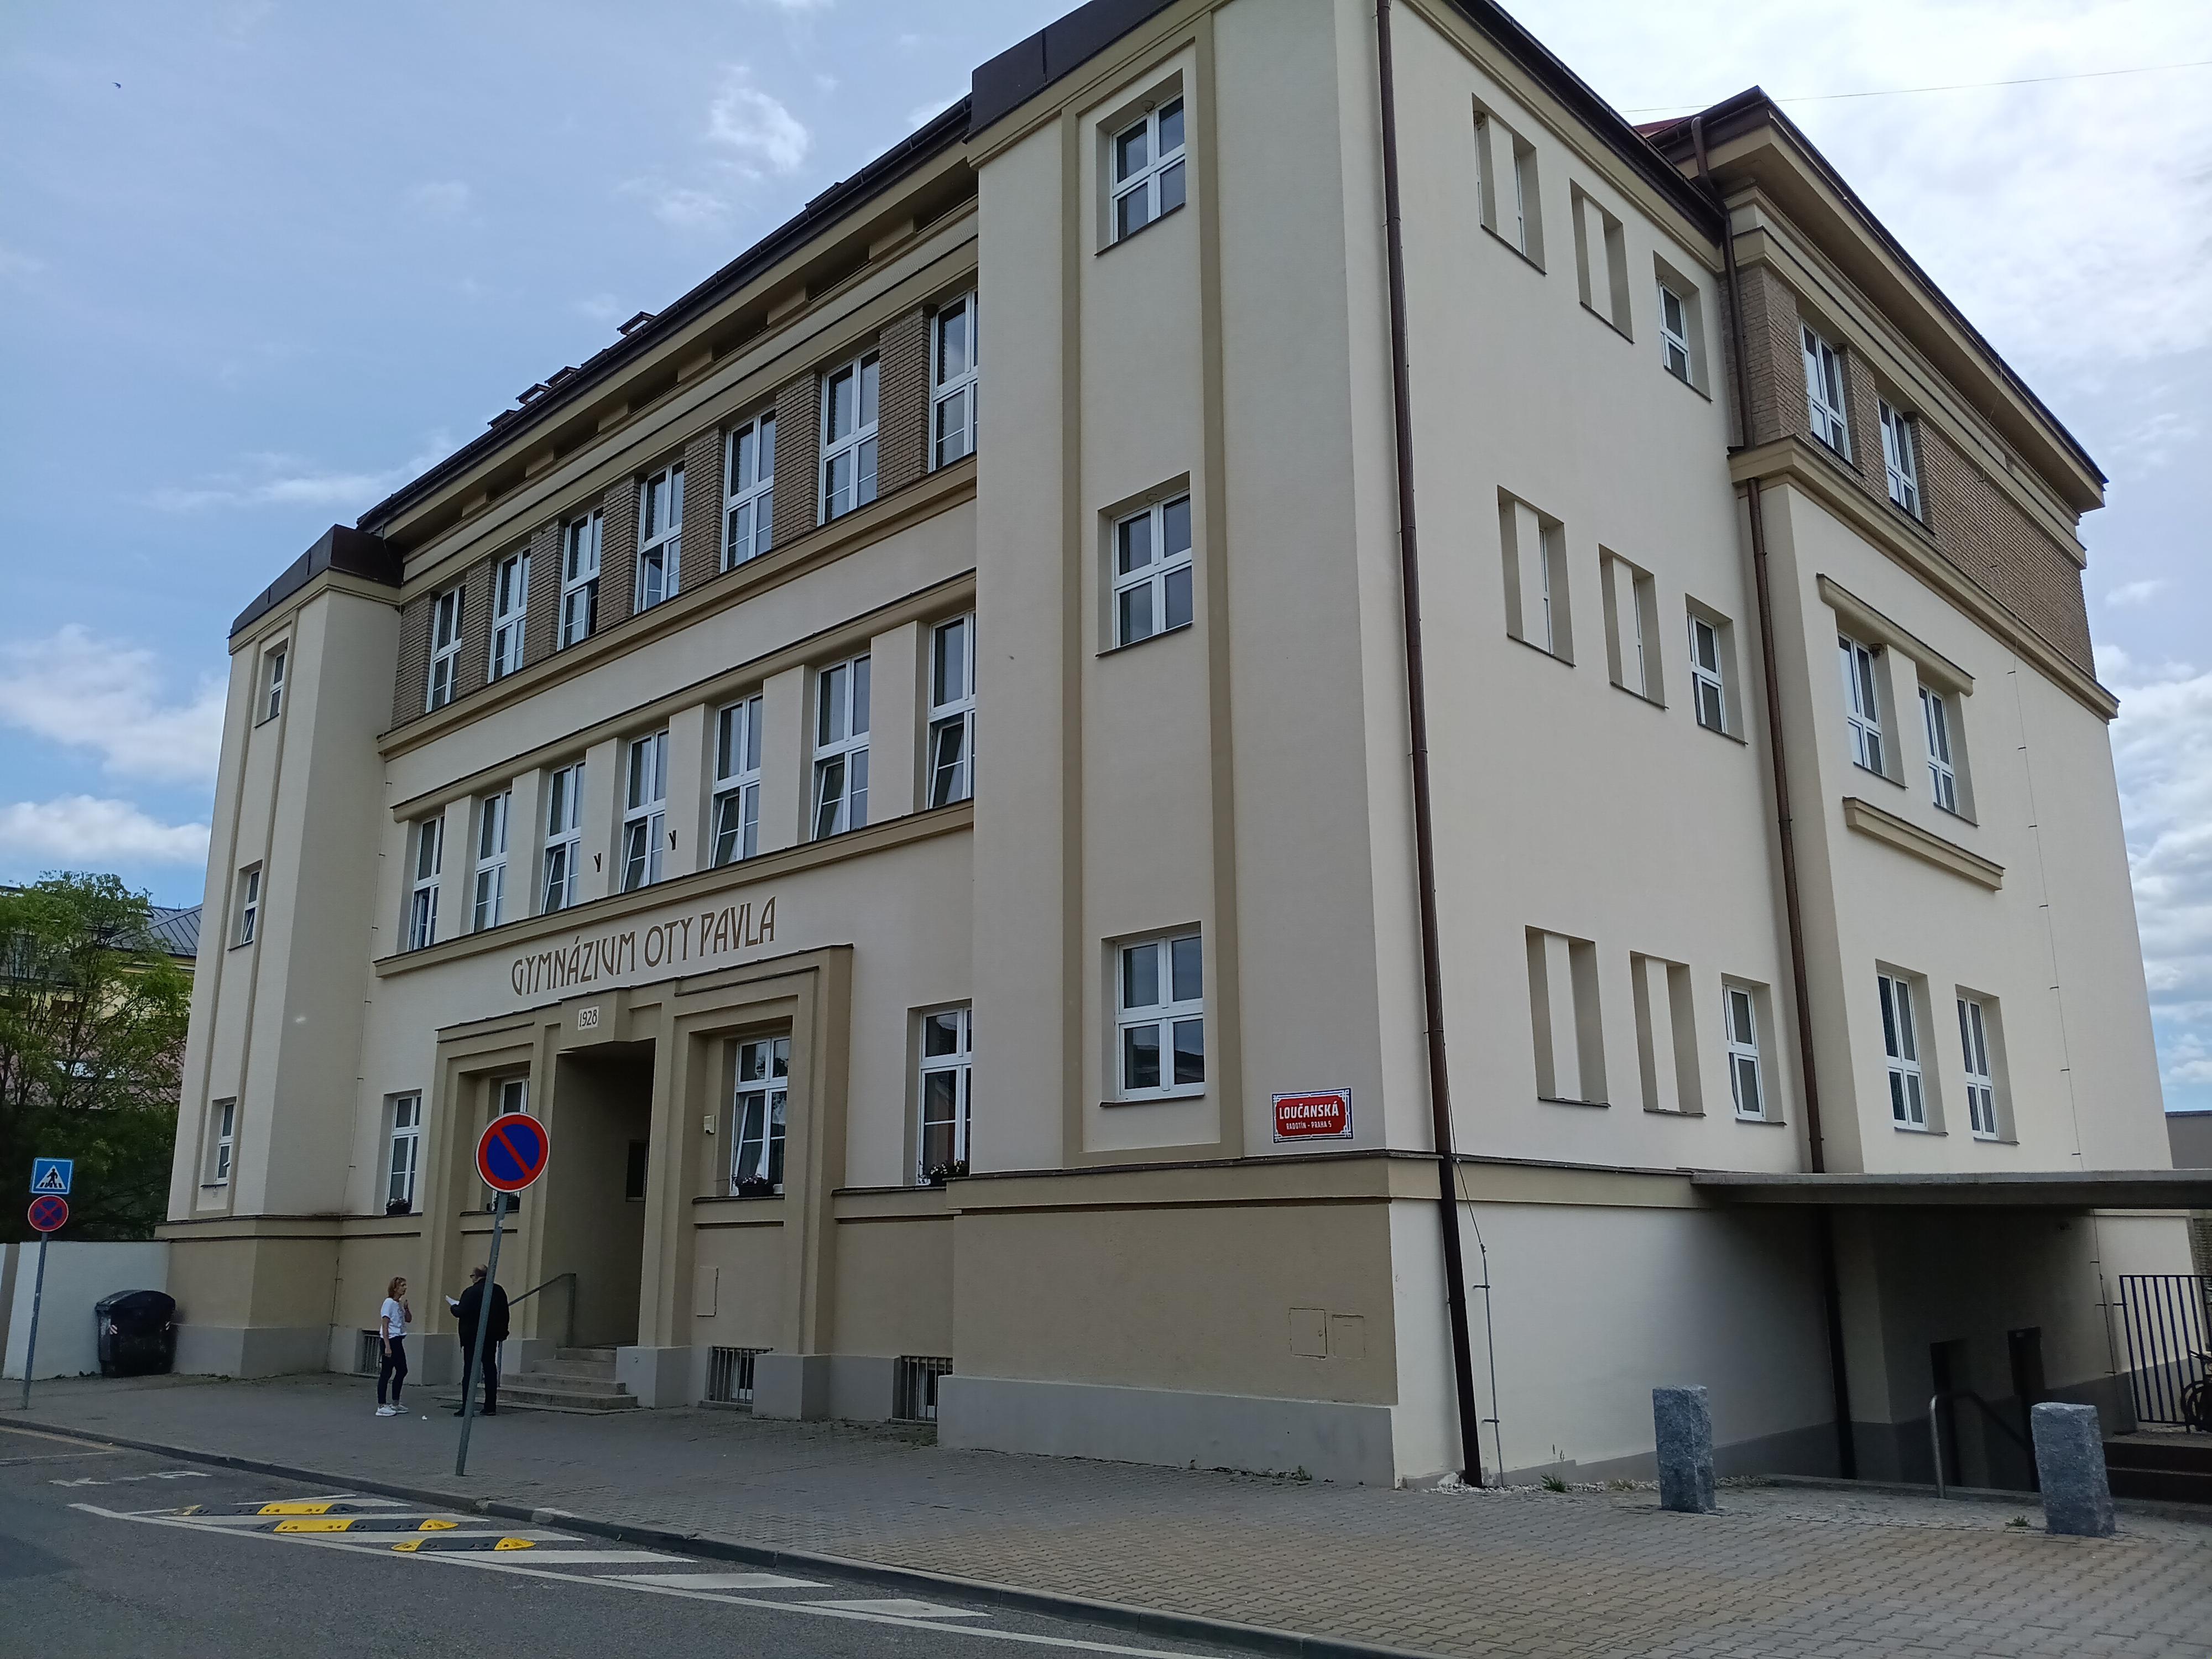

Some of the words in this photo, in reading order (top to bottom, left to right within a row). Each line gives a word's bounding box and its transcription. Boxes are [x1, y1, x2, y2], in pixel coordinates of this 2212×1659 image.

[512, 931, 635, 995] GYMNÁZIUM
[644, 916, 693, 967] OTY
[700, 896, 776, 957] PAVLA
[580, 1009, 597, 1027] 1928
[1279, 1100, 1339, 1119] LOUČANSKÁ
[1286, 1121, 1306, 1130] RADOTÍN
